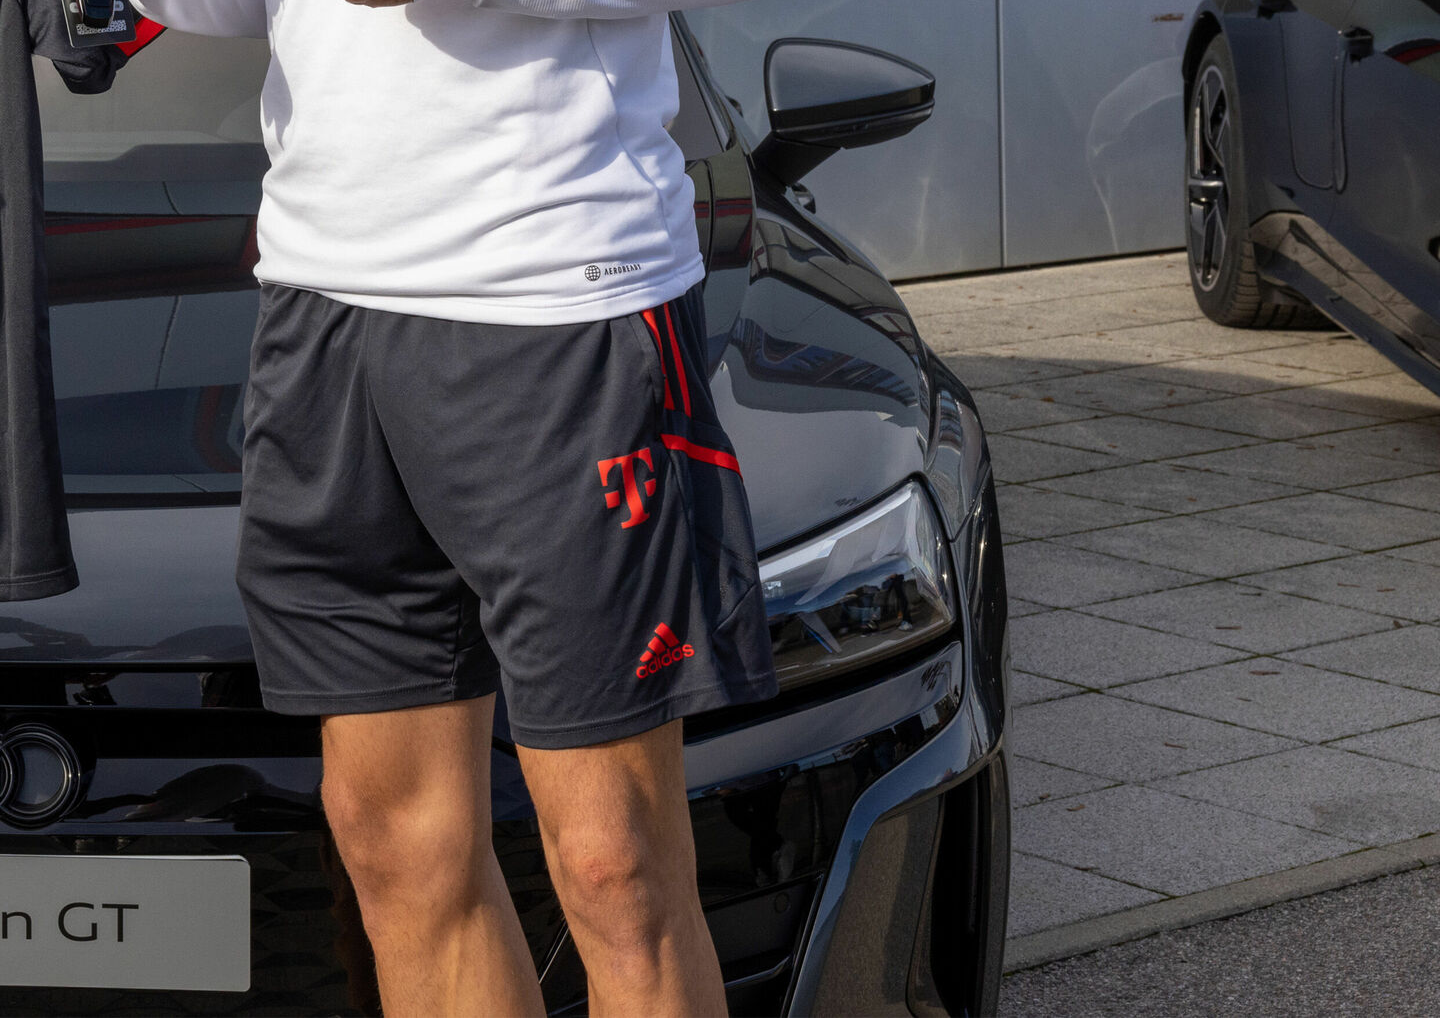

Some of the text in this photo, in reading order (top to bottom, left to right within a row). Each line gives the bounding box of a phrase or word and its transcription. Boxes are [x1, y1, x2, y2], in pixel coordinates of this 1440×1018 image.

[604, 263, 642, 276] AEROREADY
[636, 643, 696, 679] adidas
[57, 901, 140, 943] GT
